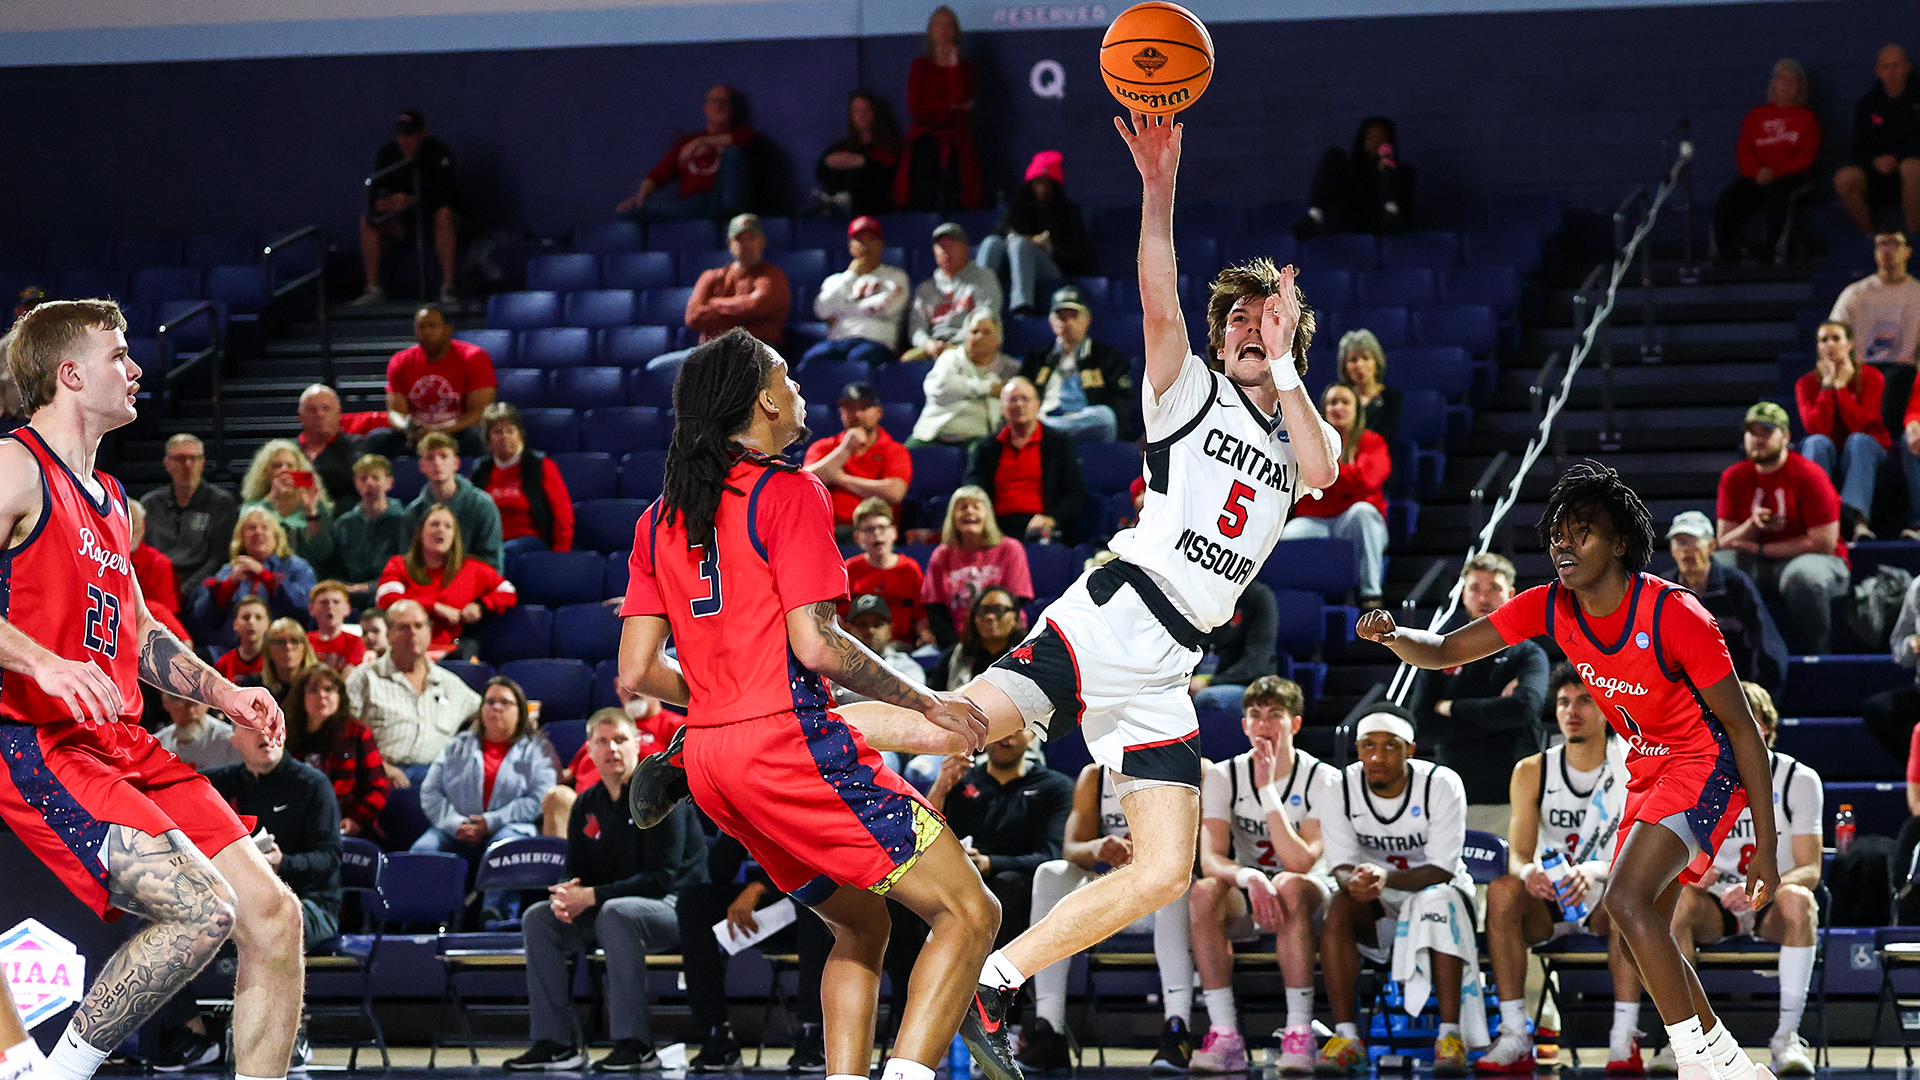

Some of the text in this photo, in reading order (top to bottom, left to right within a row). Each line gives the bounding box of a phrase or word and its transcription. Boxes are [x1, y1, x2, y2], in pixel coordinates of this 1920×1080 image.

[1029, 59, 1066, 98] Q
[1115, 84, 1191, 108] Wilson
[1203, 428, 1291, 494] CENTRAL
[1217, 479, 1257, 539] 5
[78, 527, 129, 577] Rogers
[687, 527, 723, 618] 3
[83, 582, 121, 660] 23
[1577, 662, 1649, 698] Rogers
[1614, 704, 1643, 738] 1
[1256, 840, 1277, 867] 2
[1356, 832, 1428, 851] CENTRAL
